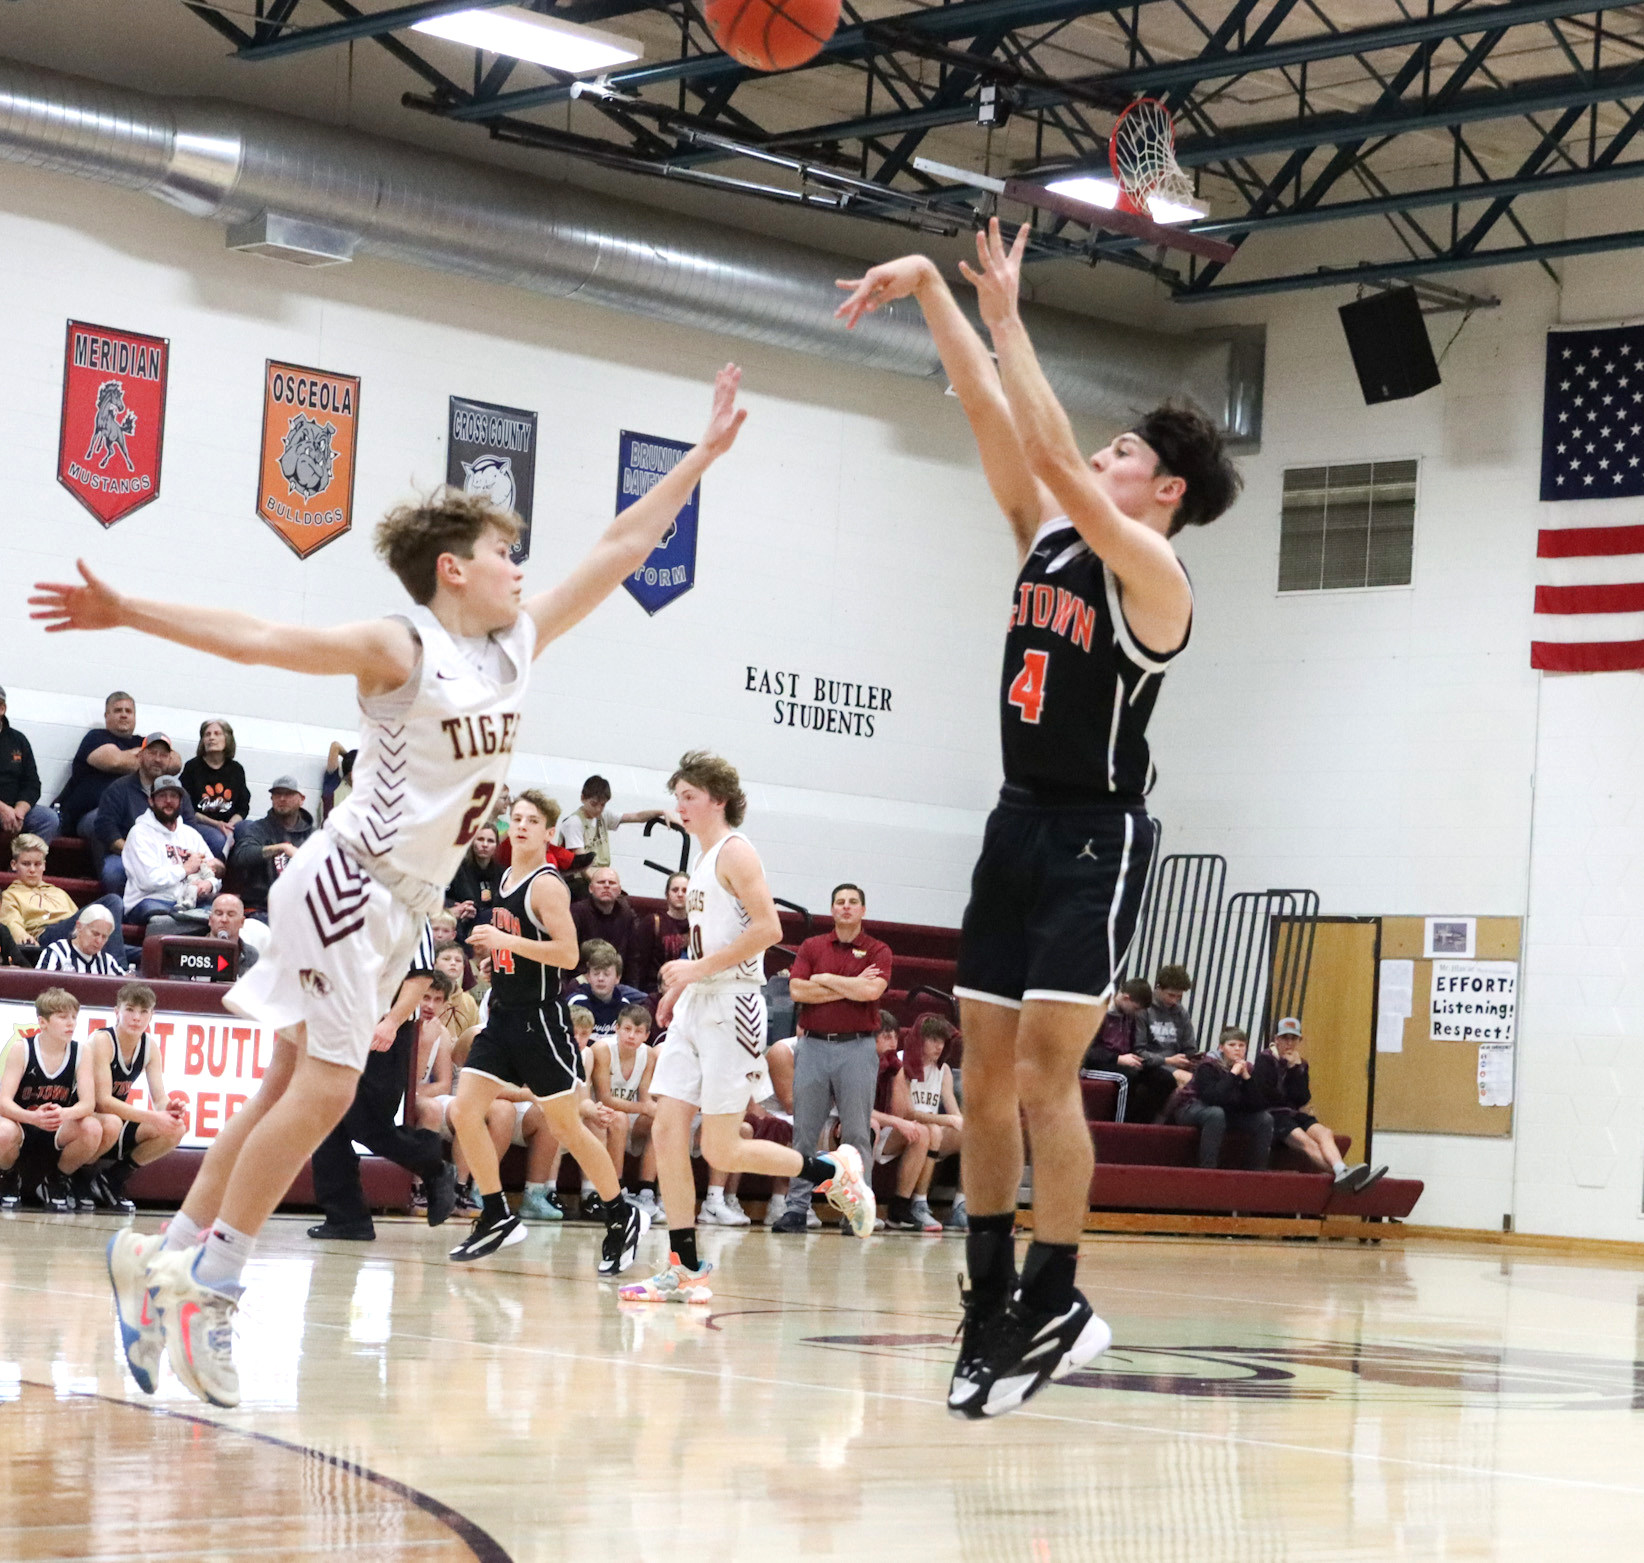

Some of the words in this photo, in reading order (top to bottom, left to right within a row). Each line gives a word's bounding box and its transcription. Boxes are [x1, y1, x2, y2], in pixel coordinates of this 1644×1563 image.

[73, 332, 162, 381] MERIDIAN
[272, 373, 353, 416] OSCEOLA
[453, 410, 488, 446] CROSS
[489, 416, 532, 452] COUNTY
[630, 440, 690, 473] BRUNIN
[67, 461, 152, 494] MUSTANGS
[264, 496, 345, 527] BULLDOGS
[633, 564, 687, 587] TORM
[745, 665, 800, 698] EAST
[813, 677, 893, 712] BUTLER
[1008, 648, 1050, 725] 4
[440, 712, 520, 760] TIGE
[773, 699, 875, 738] STUDENTS
[689, 923, 704, 961] 0
[179, 954, 214, 969] POSS.
[1436, 976, 1514, 994] EFFORT!
[1432, 999, 1514, 1019] Listening!
[1433, 1021, 1512, 1040] Respect!
[184, 1024, 280, 1080] BUTL
[911, 1090, 939, 1107] TIERS
